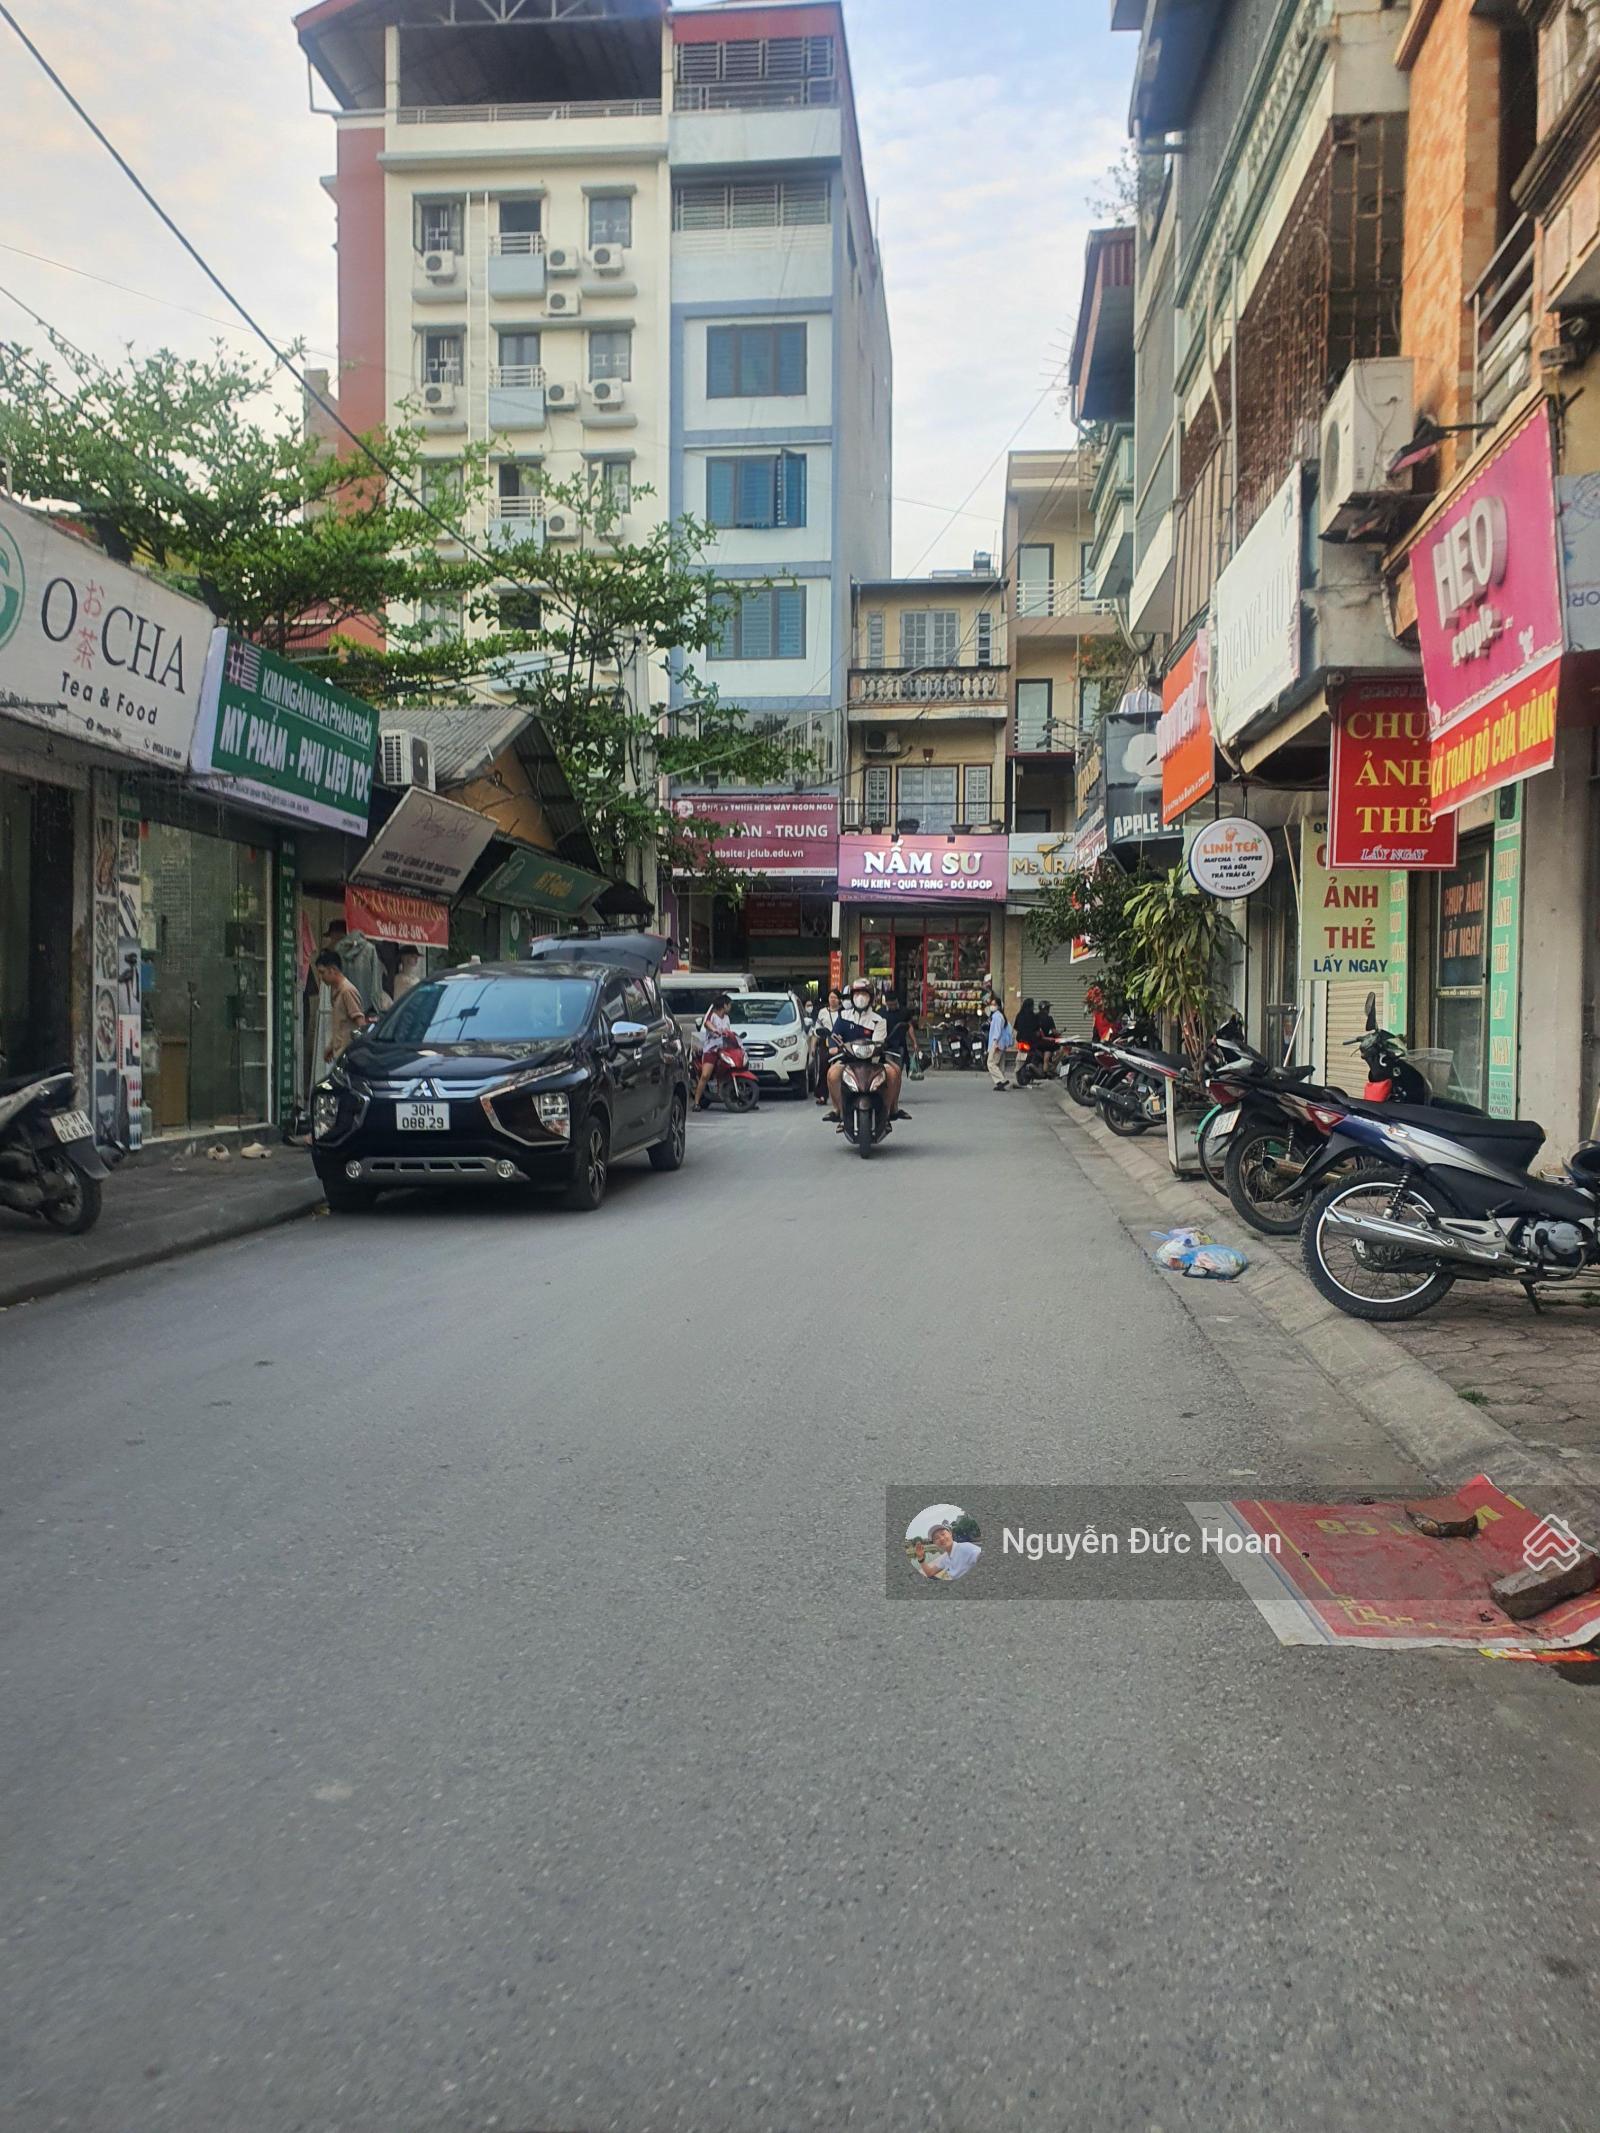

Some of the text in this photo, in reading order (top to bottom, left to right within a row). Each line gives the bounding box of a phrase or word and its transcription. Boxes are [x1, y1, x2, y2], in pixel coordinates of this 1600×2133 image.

[1433, 497, 1500, 625] HEO
[41, 577, 186, 695] O CHA
[61, 671, 158, 725] Tea & Food
[262, 667, 283, 704] KIM
[1346, 712, 1430, 745] CHỤ
[1445, 733, 1473, 791] TOÀN
[1473, 717, 1490, 782] BỘ
[1491, 699, 1517, 766] CỬA
[1354, 750, 1431, 786] ẢNH
[1113, 813, 1159, 839] APPLE
[1356, 797, 1434, 833] THẺ
[775, 824, 828, 838] TRUNG
[747, 849, 804, 860] jclub.edu.vn
[1203, 841, 1259, 854] LINH TEA
[1360, 845, 1429, 860] LẤY NGAY
[941, 852, 983, 876] SU
[966, 880, 993, 889] KPOP
[1324, 876, 1379, 908] ẢNH
[1324, 918, 1376, 949] THẺ
[1458, 924, 1482, 957] NGAY
[1313, 953, 1389, 973] LẤY NGAY
[402, 1117, 445, 1129] 088.29
[411, 1103, 435, 1117] 30H
